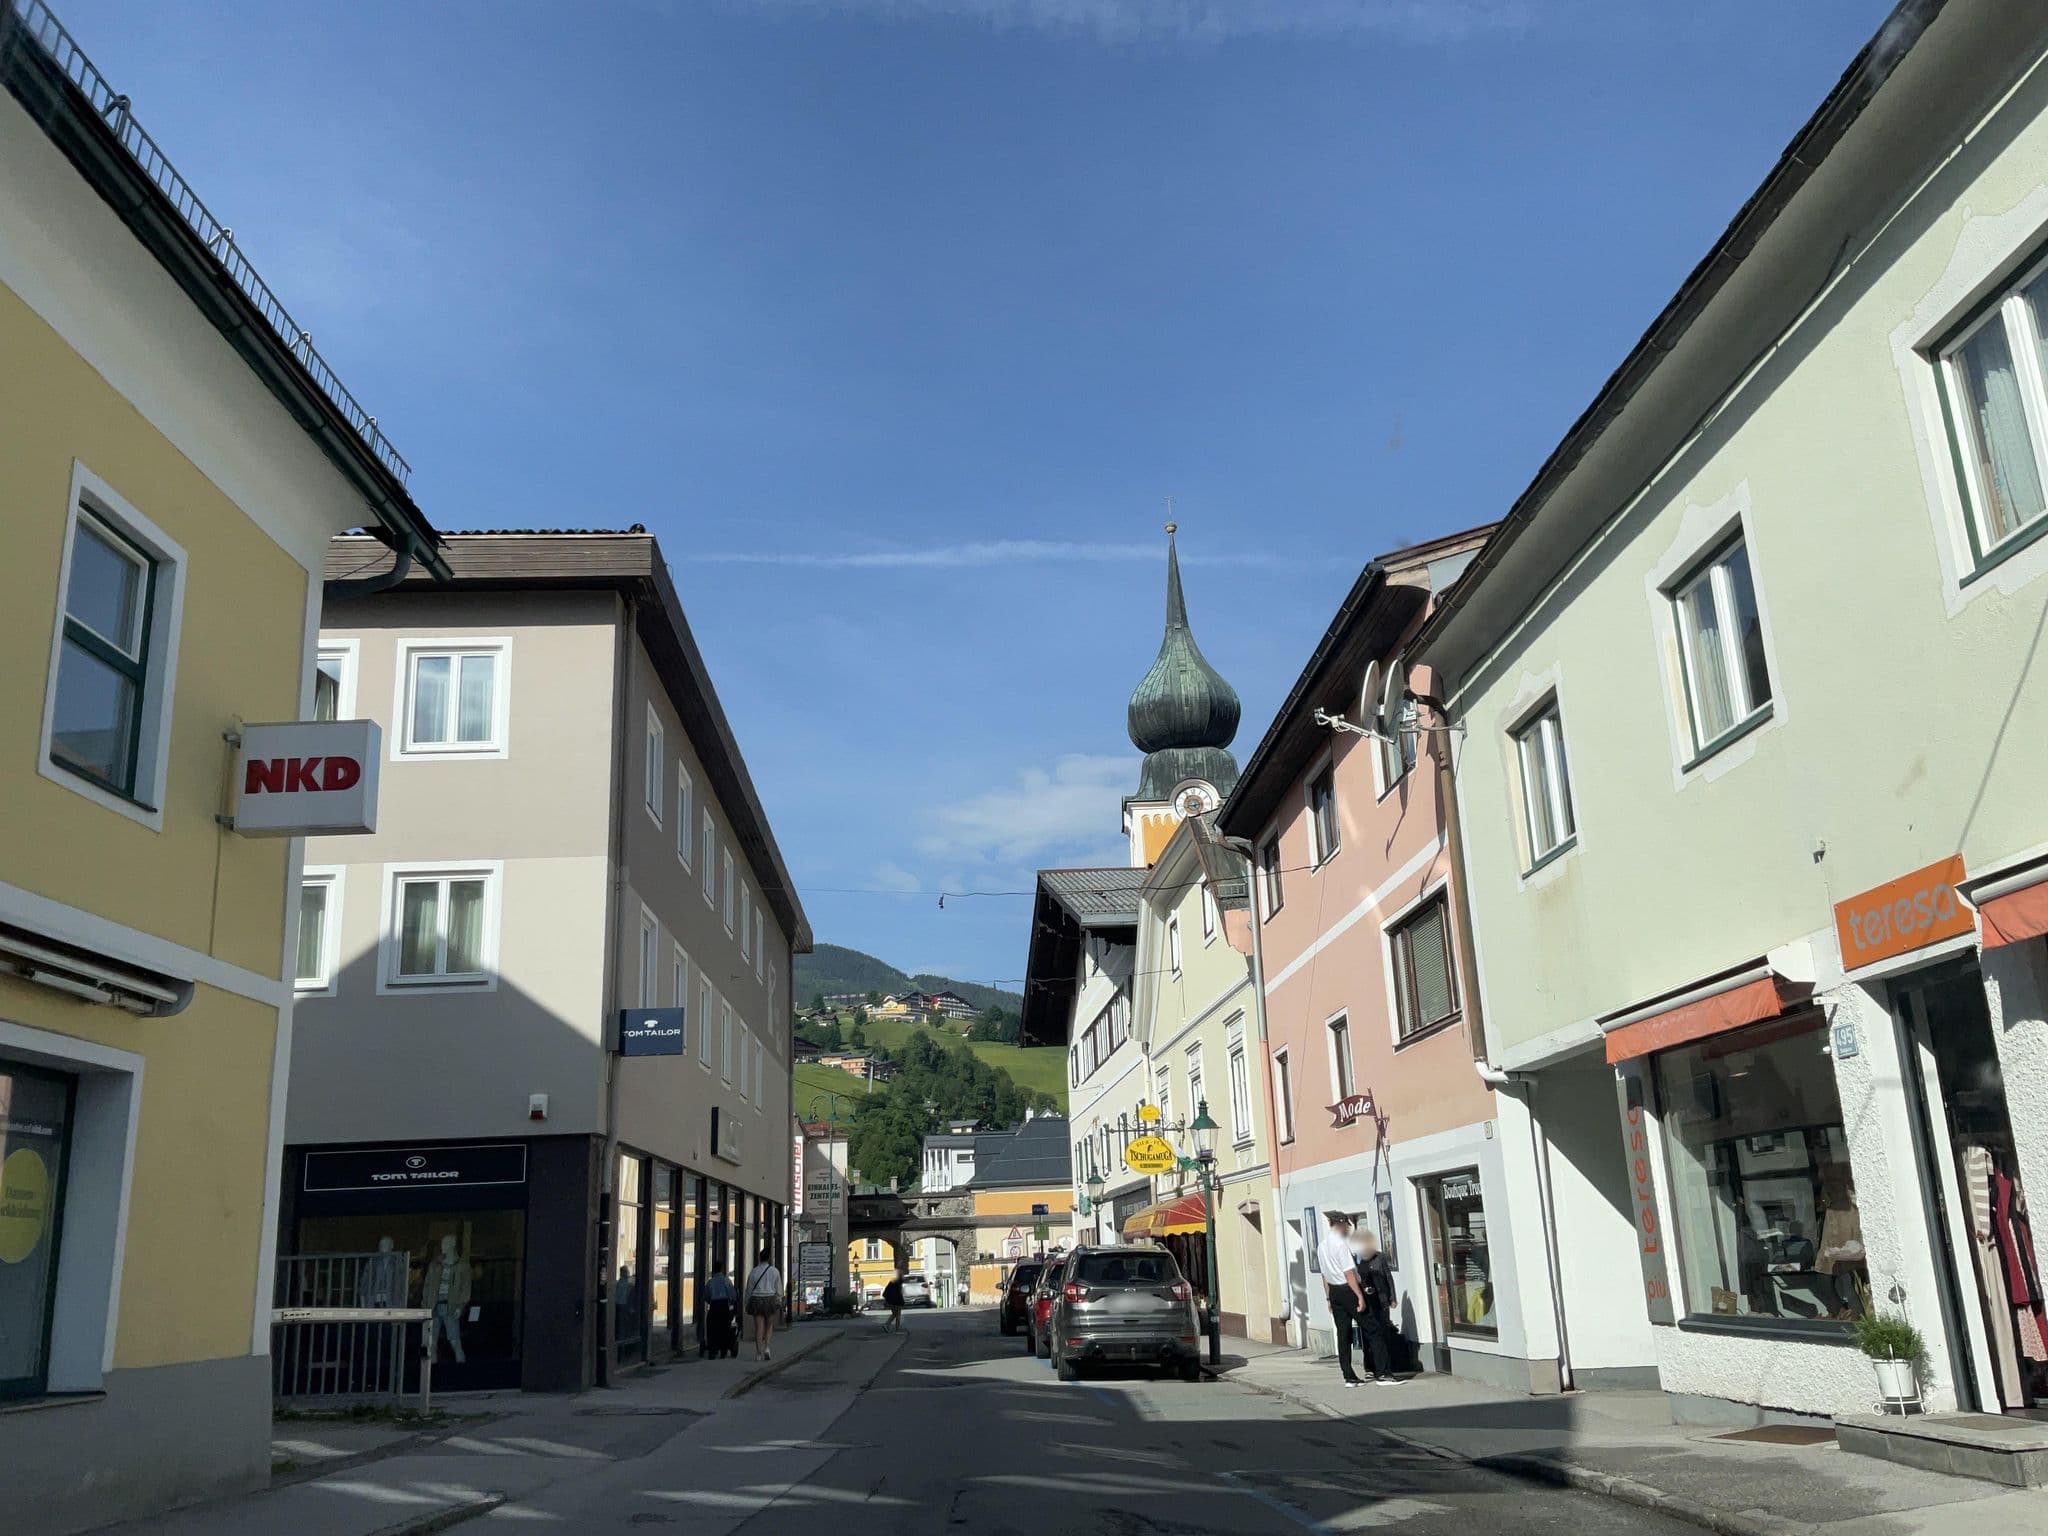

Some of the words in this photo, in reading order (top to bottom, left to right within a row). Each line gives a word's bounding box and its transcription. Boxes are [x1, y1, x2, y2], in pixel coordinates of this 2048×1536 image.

[245, 756, 361, 795] NKD
[1849, 883, 1957, 950] teresa
[644, 1028, 681, 1036] TAILOR
[1338, 1097, 1371, 1123] Mode
[371, 1173, 407, 1181] TOM
[409, 1171, 460, 1179] TAILOR
[1442, 1183, 1469, 1201] Boutique
